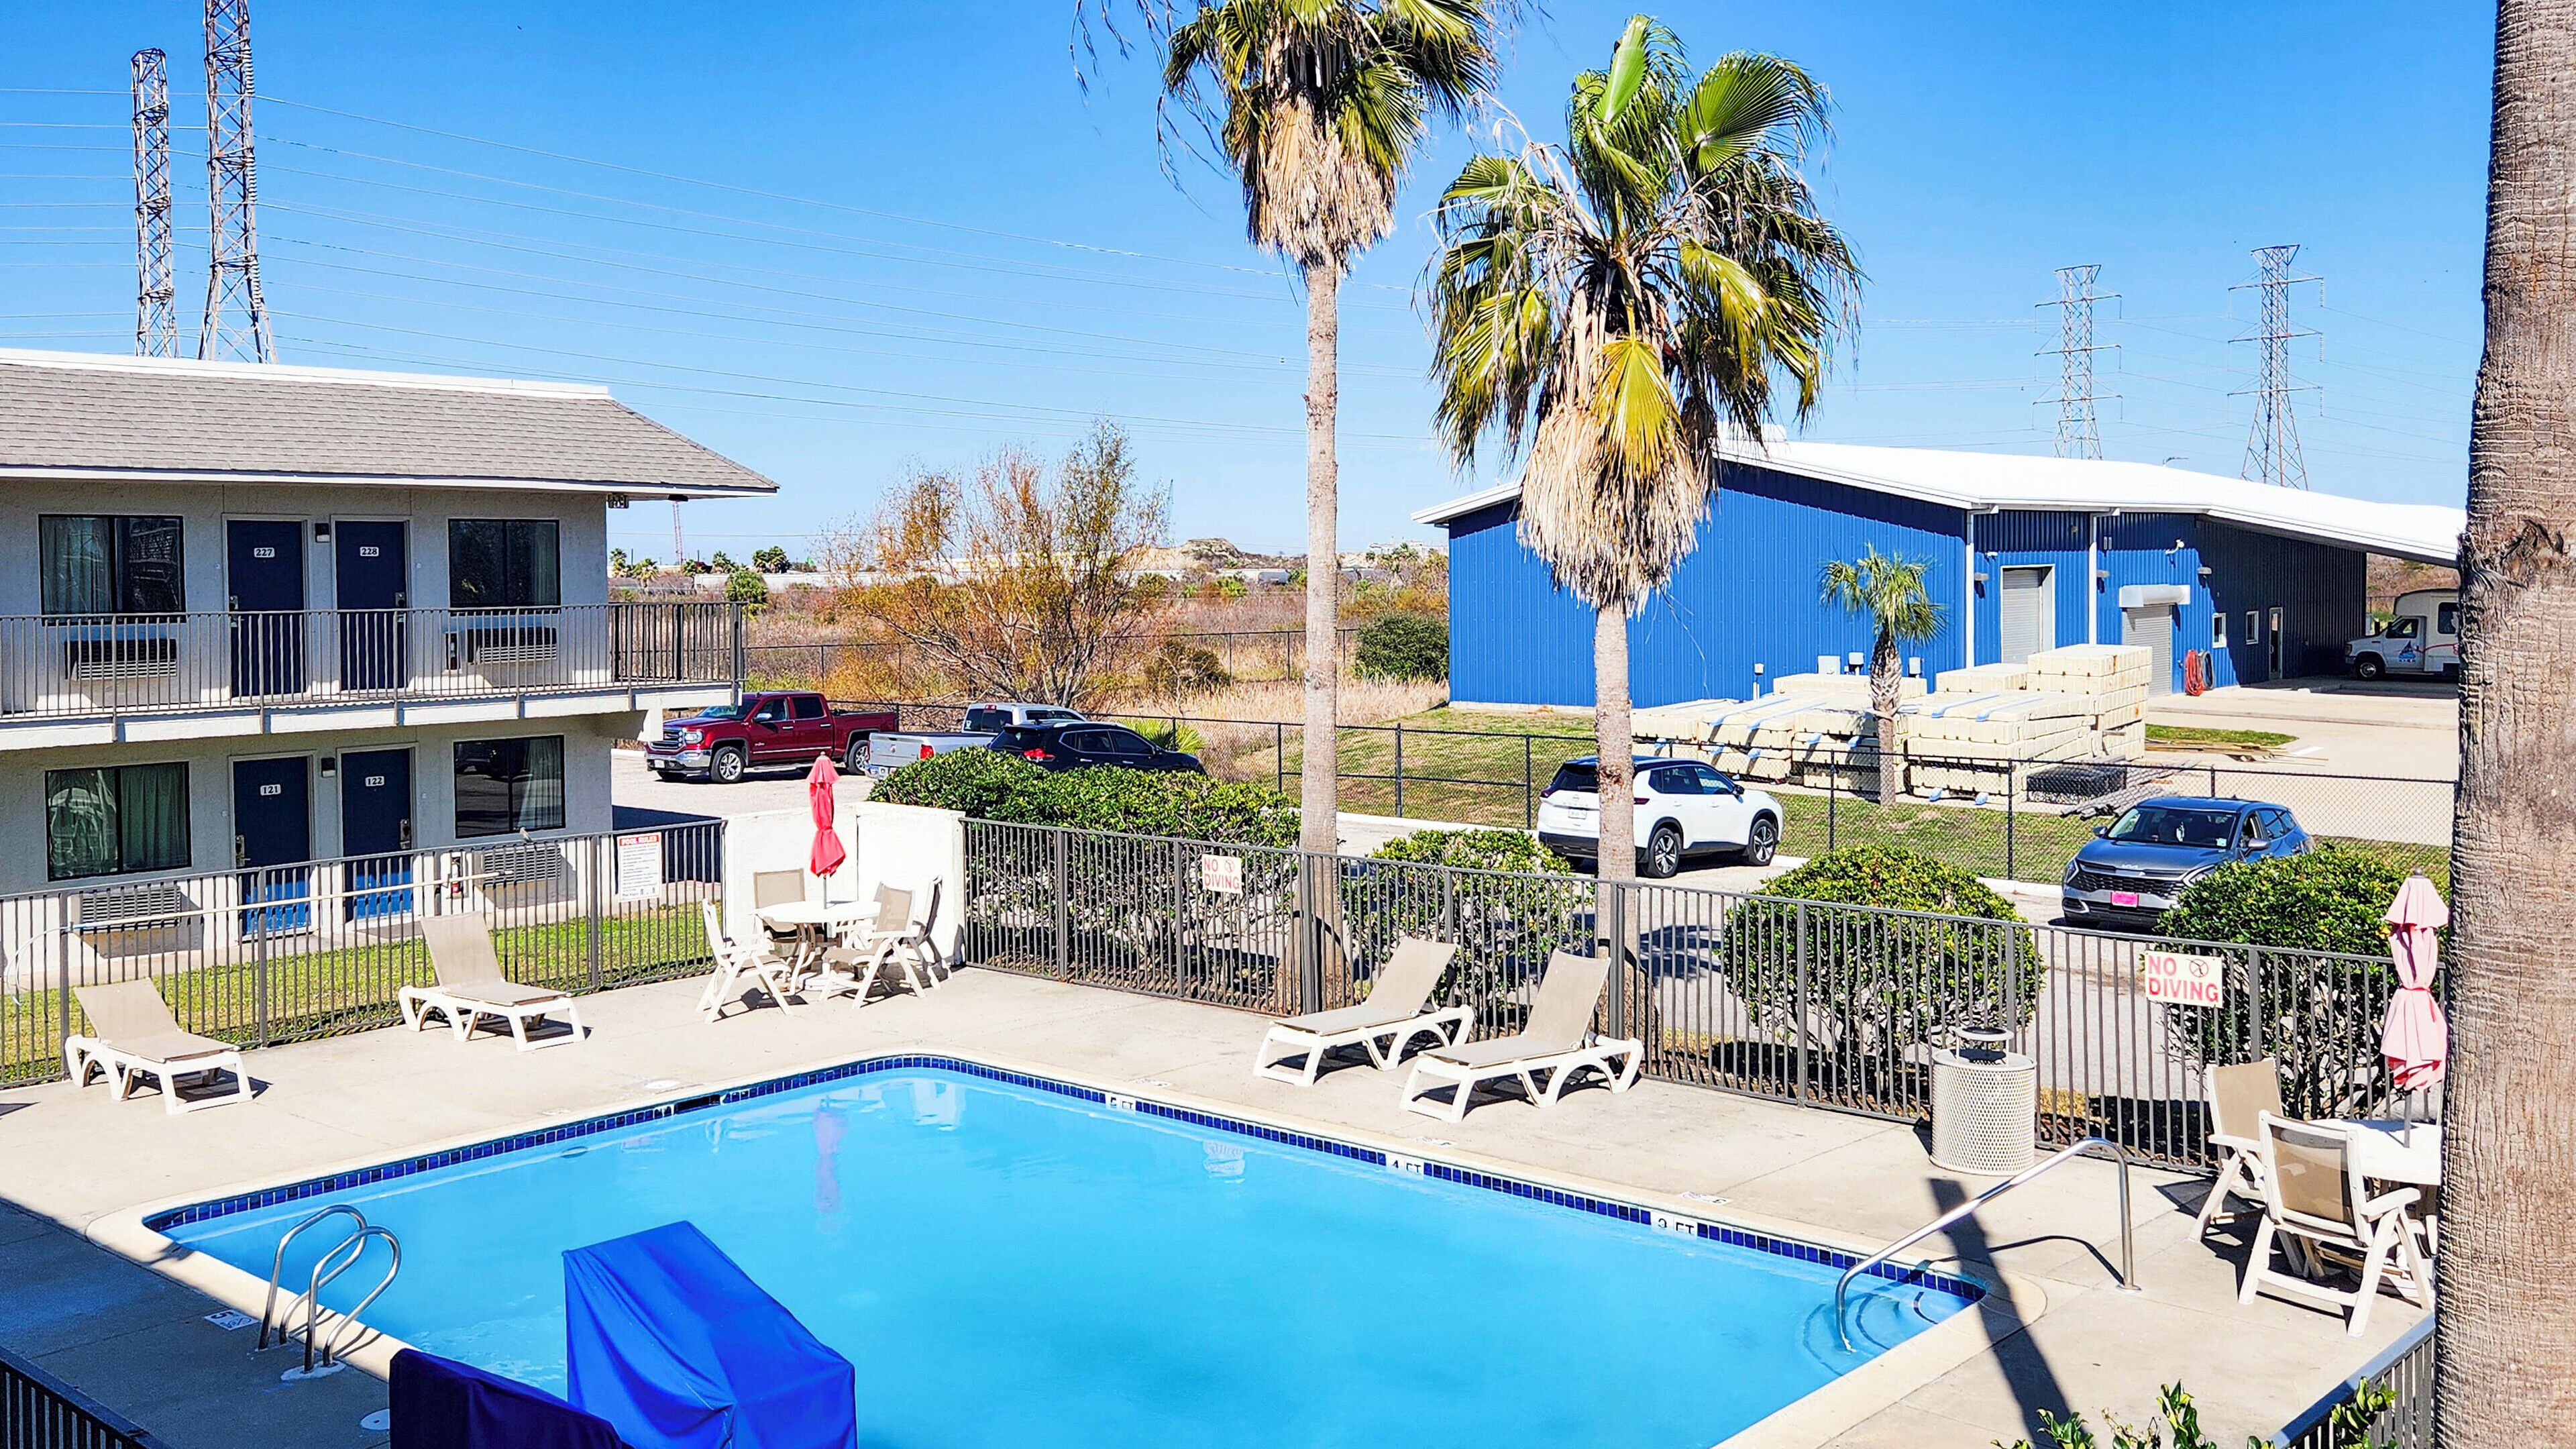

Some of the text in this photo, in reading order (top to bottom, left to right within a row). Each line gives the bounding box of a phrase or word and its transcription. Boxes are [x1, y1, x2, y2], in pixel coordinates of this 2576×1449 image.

[264, 786, 279, 794] 121
[622, 837, 637, 845] POOL
[1204, 858, 1218, 872] NO
[1204, 873, 1240, 890] DIVING
[2148, 955, 2177, 976] NO
[2149, 977, 2218, 1002] DIVING
[1406, 1163, 1421, 1173] FT
[1676, 1222, 1695, 1234] FT
